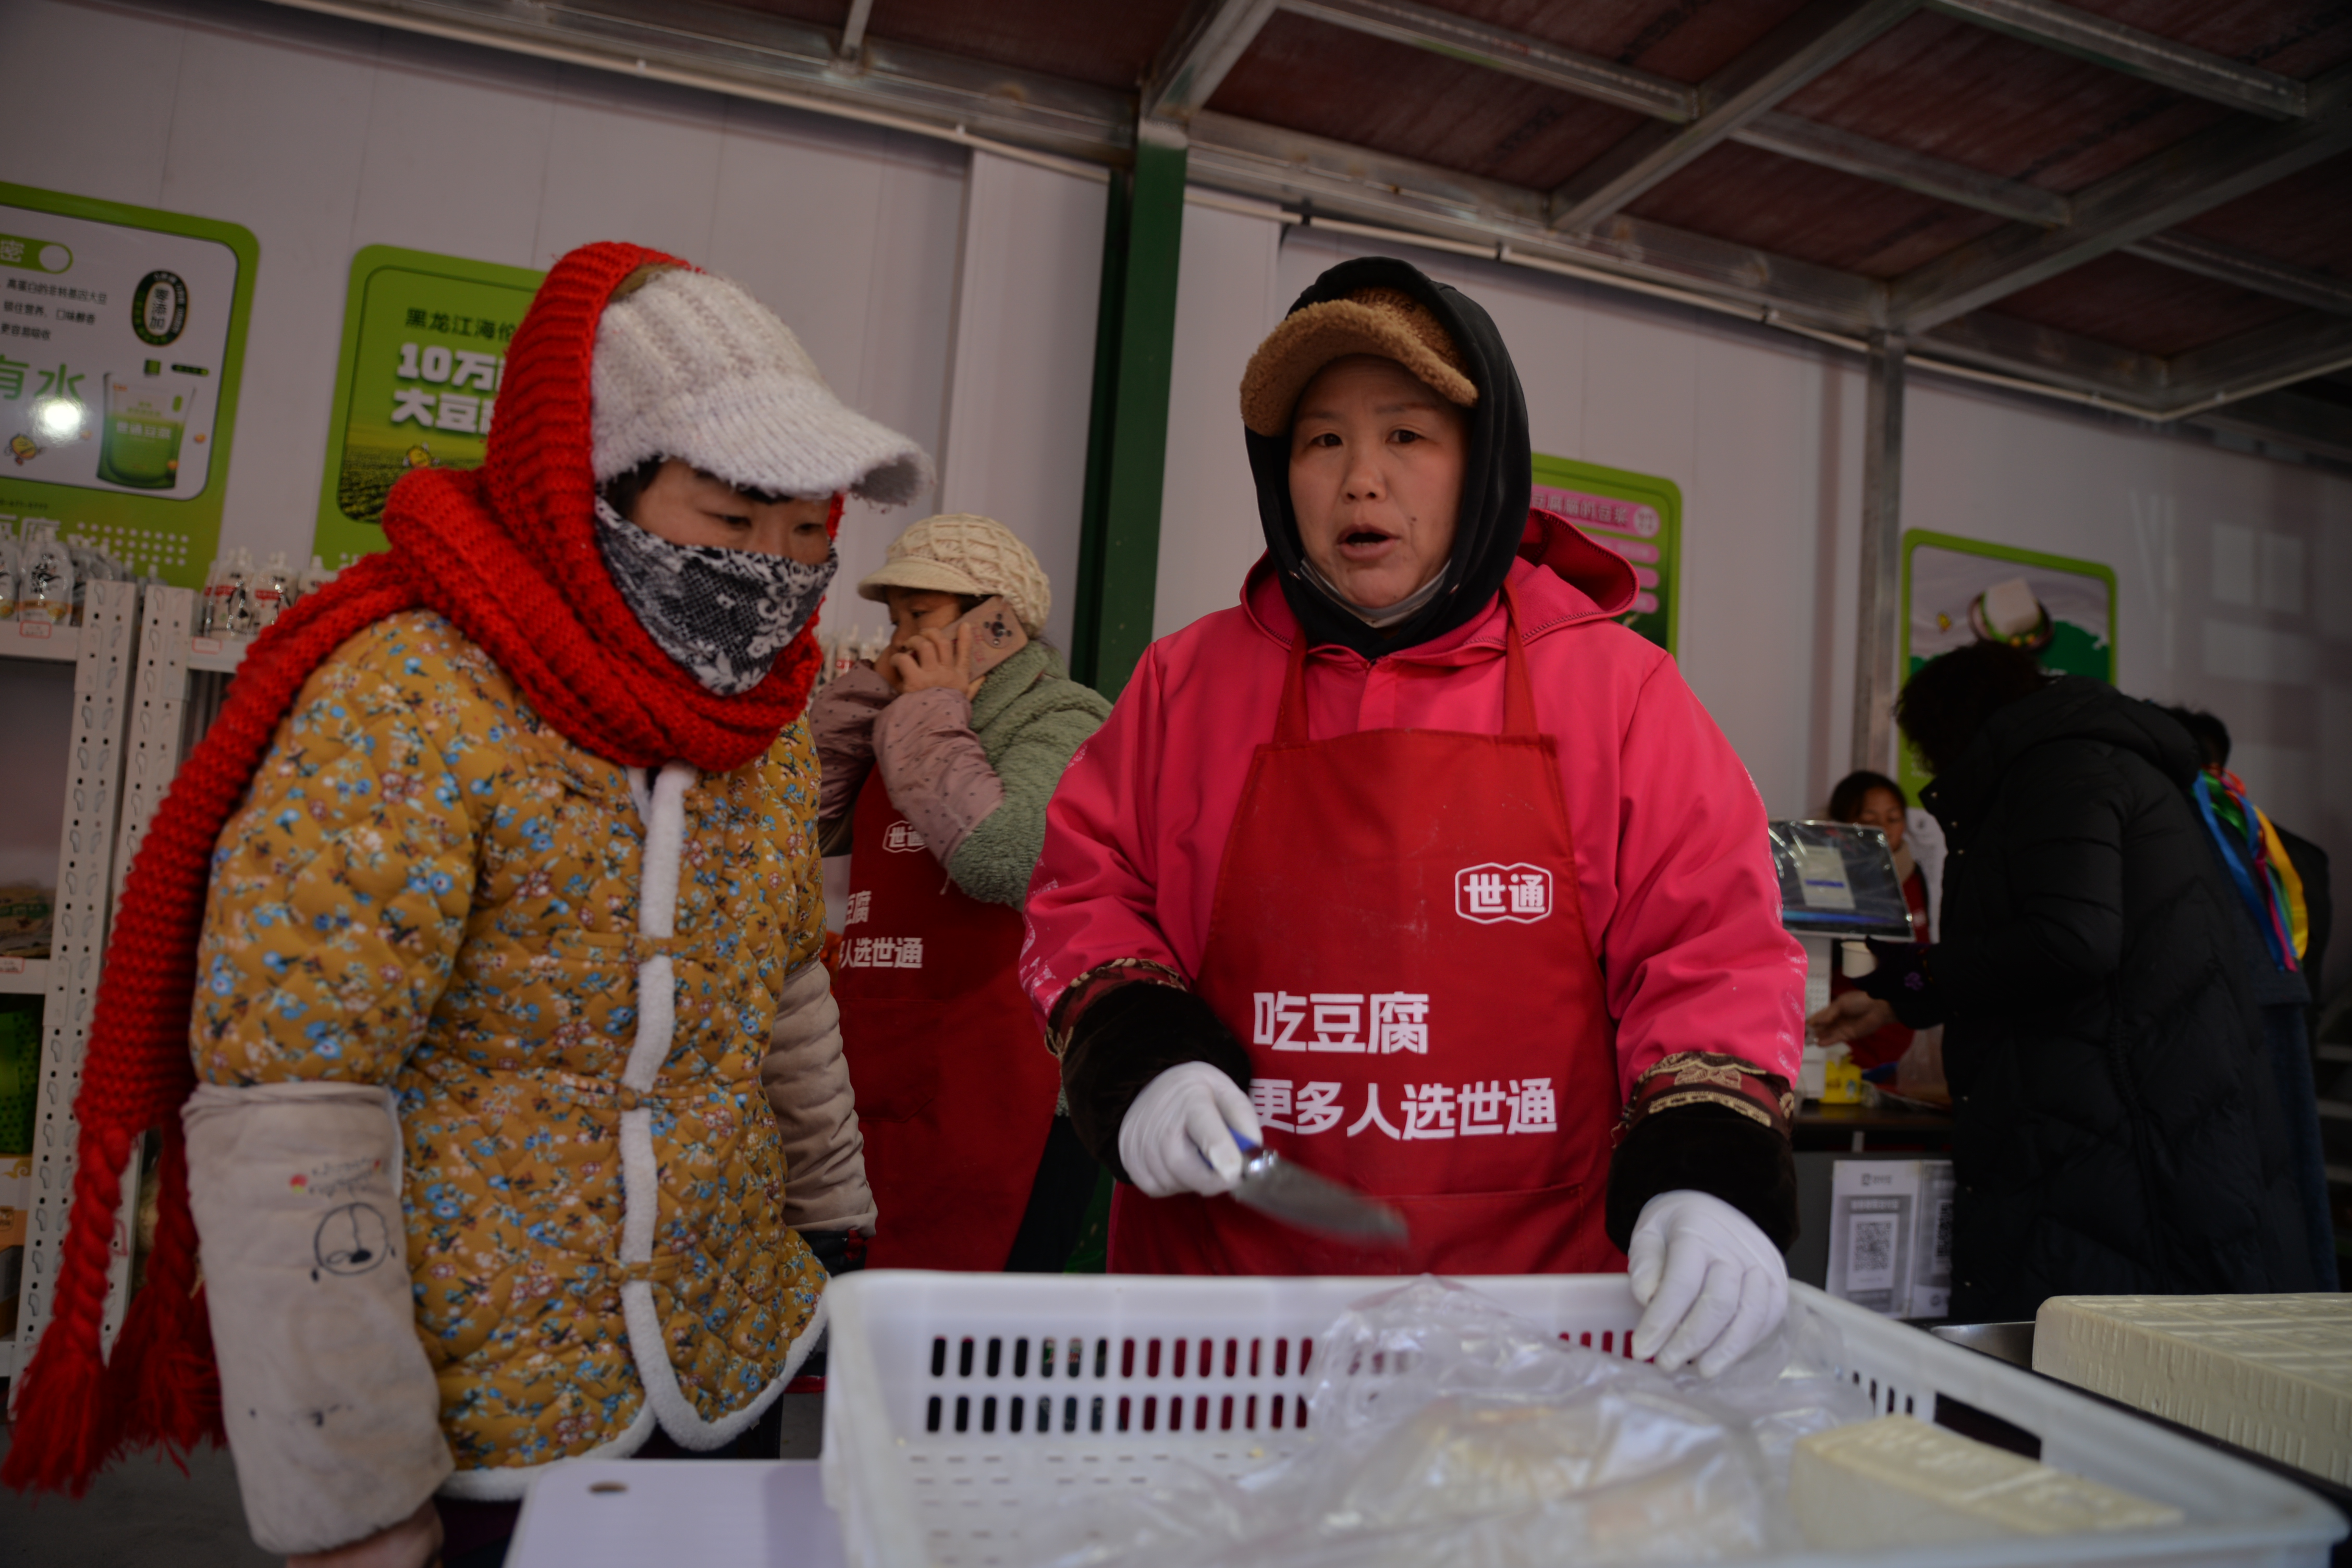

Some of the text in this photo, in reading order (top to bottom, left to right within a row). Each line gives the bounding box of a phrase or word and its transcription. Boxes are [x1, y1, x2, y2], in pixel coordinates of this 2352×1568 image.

[397, 342, 506, 391] 10万
[1464, 873, 1546, 913] 世通
[838, 936, 924, 969] 人选世通
[1253, 990, 1430, 1055] 吃豆腐
[1249, 1077, 1558, 1142] 更多人选世通
